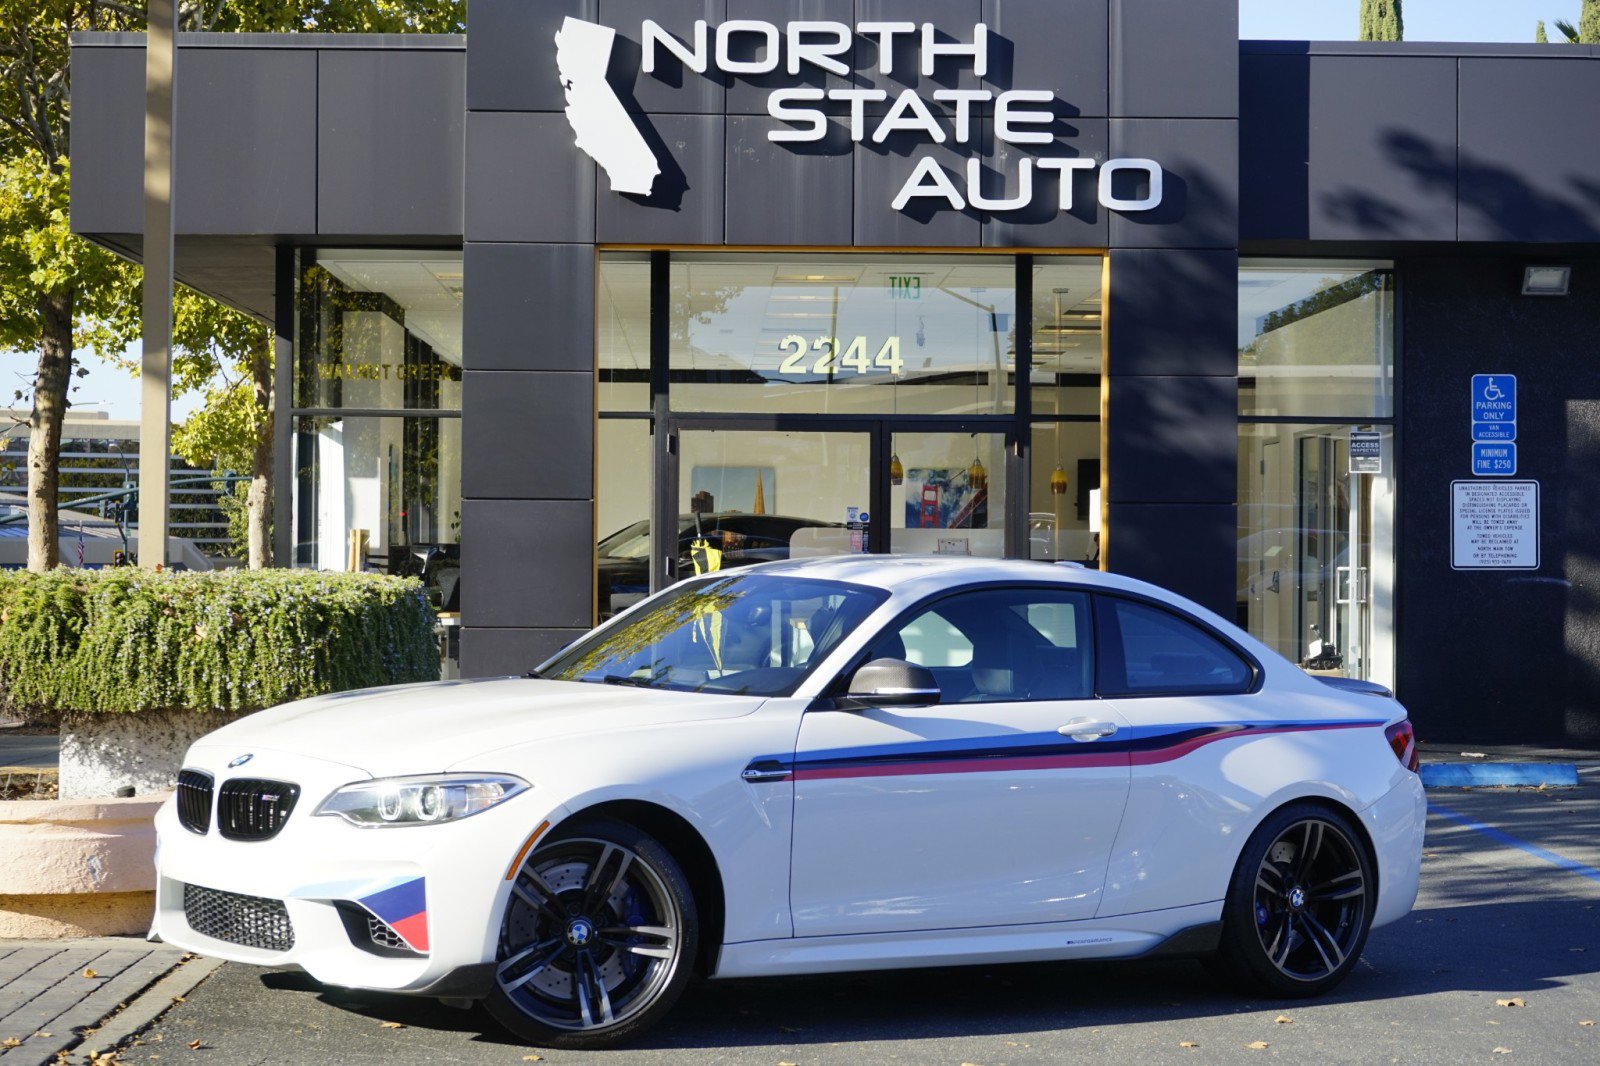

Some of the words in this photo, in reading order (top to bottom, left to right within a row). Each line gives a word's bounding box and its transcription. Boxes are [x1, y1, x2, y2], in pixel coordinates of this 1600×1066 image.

[641, 19, 987, 77] NORTH
[766, 88, 1055, 144] STATE
[890, 156, 1163, 211] AUTO
[778, 334, 904, 375] 2244
[317, 363, 391, 380] WALNUT
[1476, 402, 1512, 410] PARKING
[1483, 412, 1504, 420] ONLY
[1480, 449, 1508, 457] MINIMUM
[1477, 460, 1490, 468] FINE
[1494, 460, 1512, 469] $250
